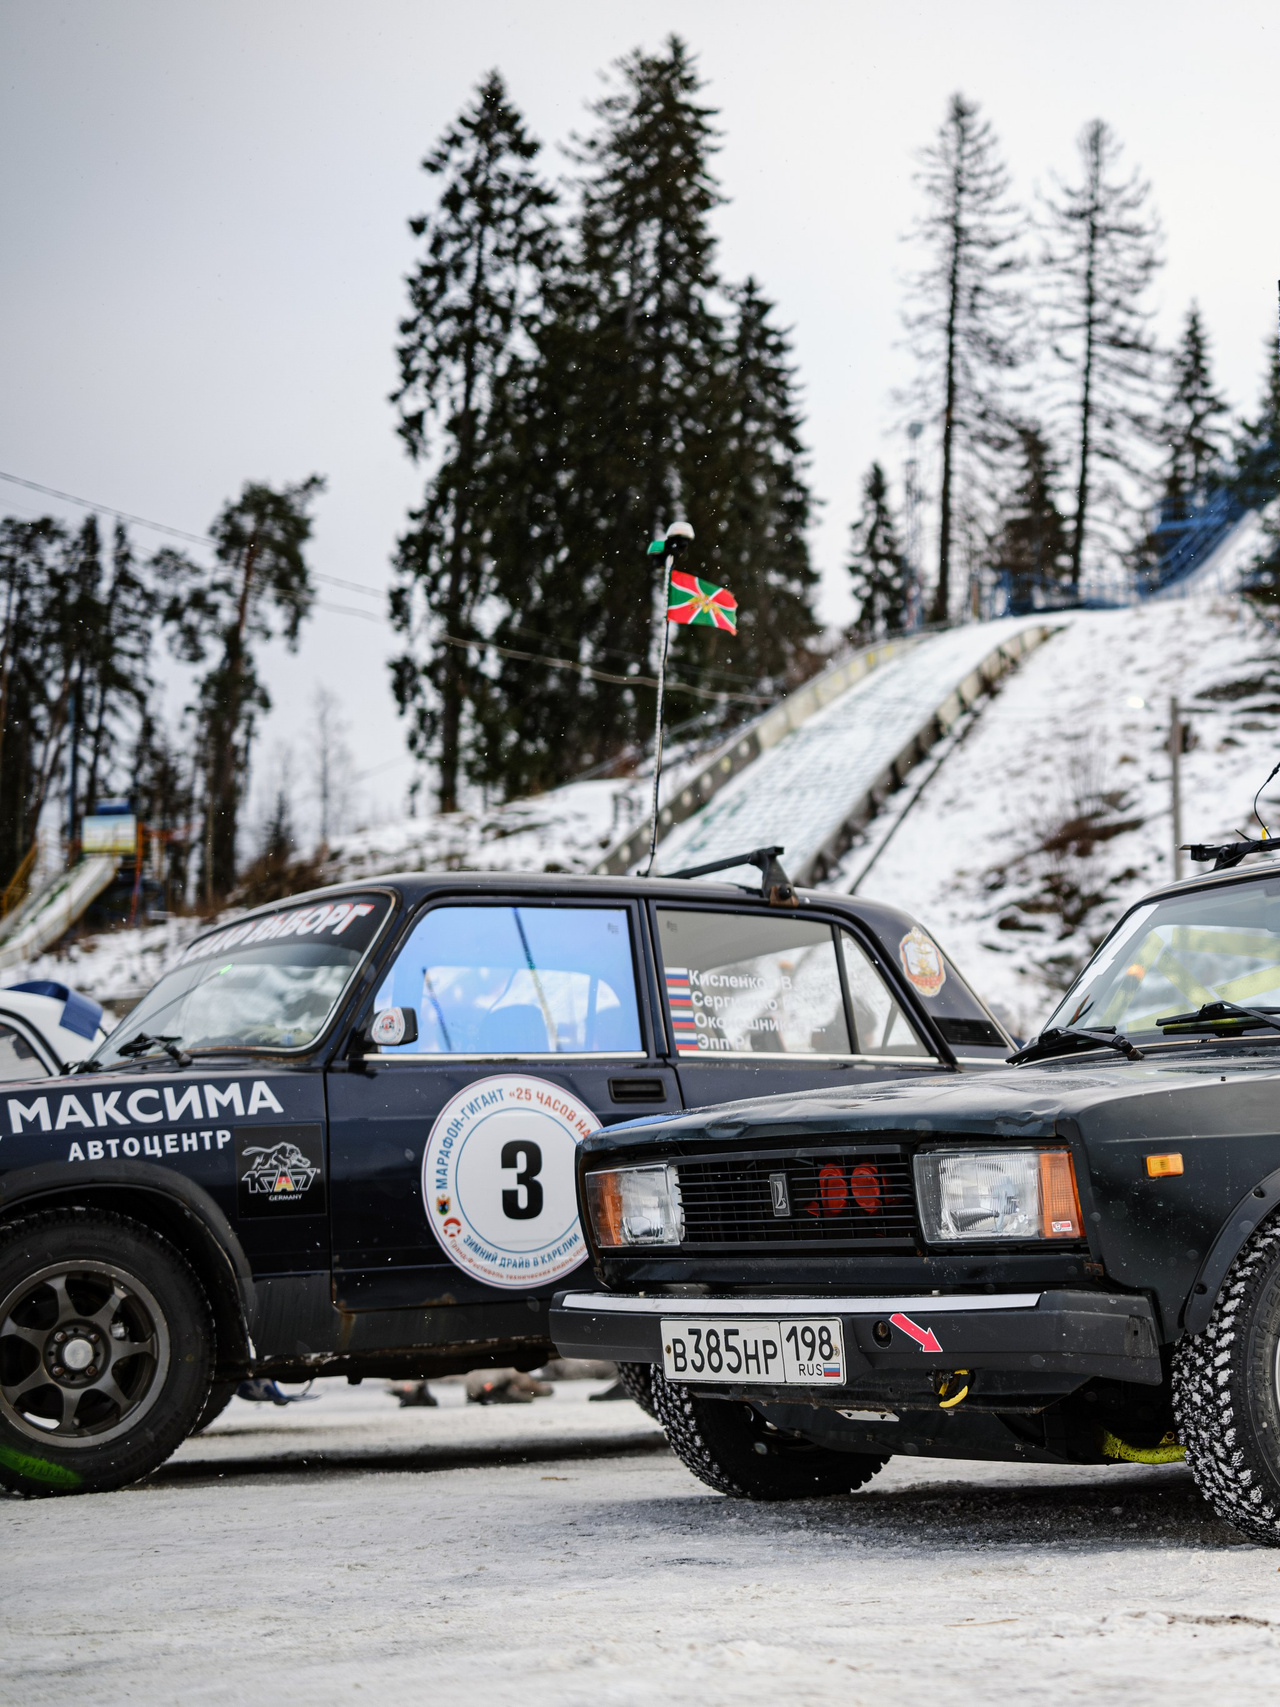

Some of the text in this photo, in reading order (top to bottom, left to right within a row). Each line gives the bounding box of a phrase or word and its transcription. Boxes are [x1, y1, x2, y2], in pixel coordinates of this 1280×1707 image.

[241, 903, 375, 946] ВЫБОРГ
[7, 1080, 284, 1134] МАКСИМА
[68, 1130, 231, 1162] АВТОЦЕНТР
[436, 1087, 591, 1190] МАРАФОН-ГИГАНТ «25 ЧАСОВ НА
[269, 1193, 302, 1202] GERMANY
[501, 1139, 544, 1220] 3
[463, 1233, 580, 1269] ЗИМНИЙ ДРАЙВ В КАРЕЛИИ
[672, 1325, 834, 1375] В385НР 198
[799, 1363, 823, 1376] RUS
